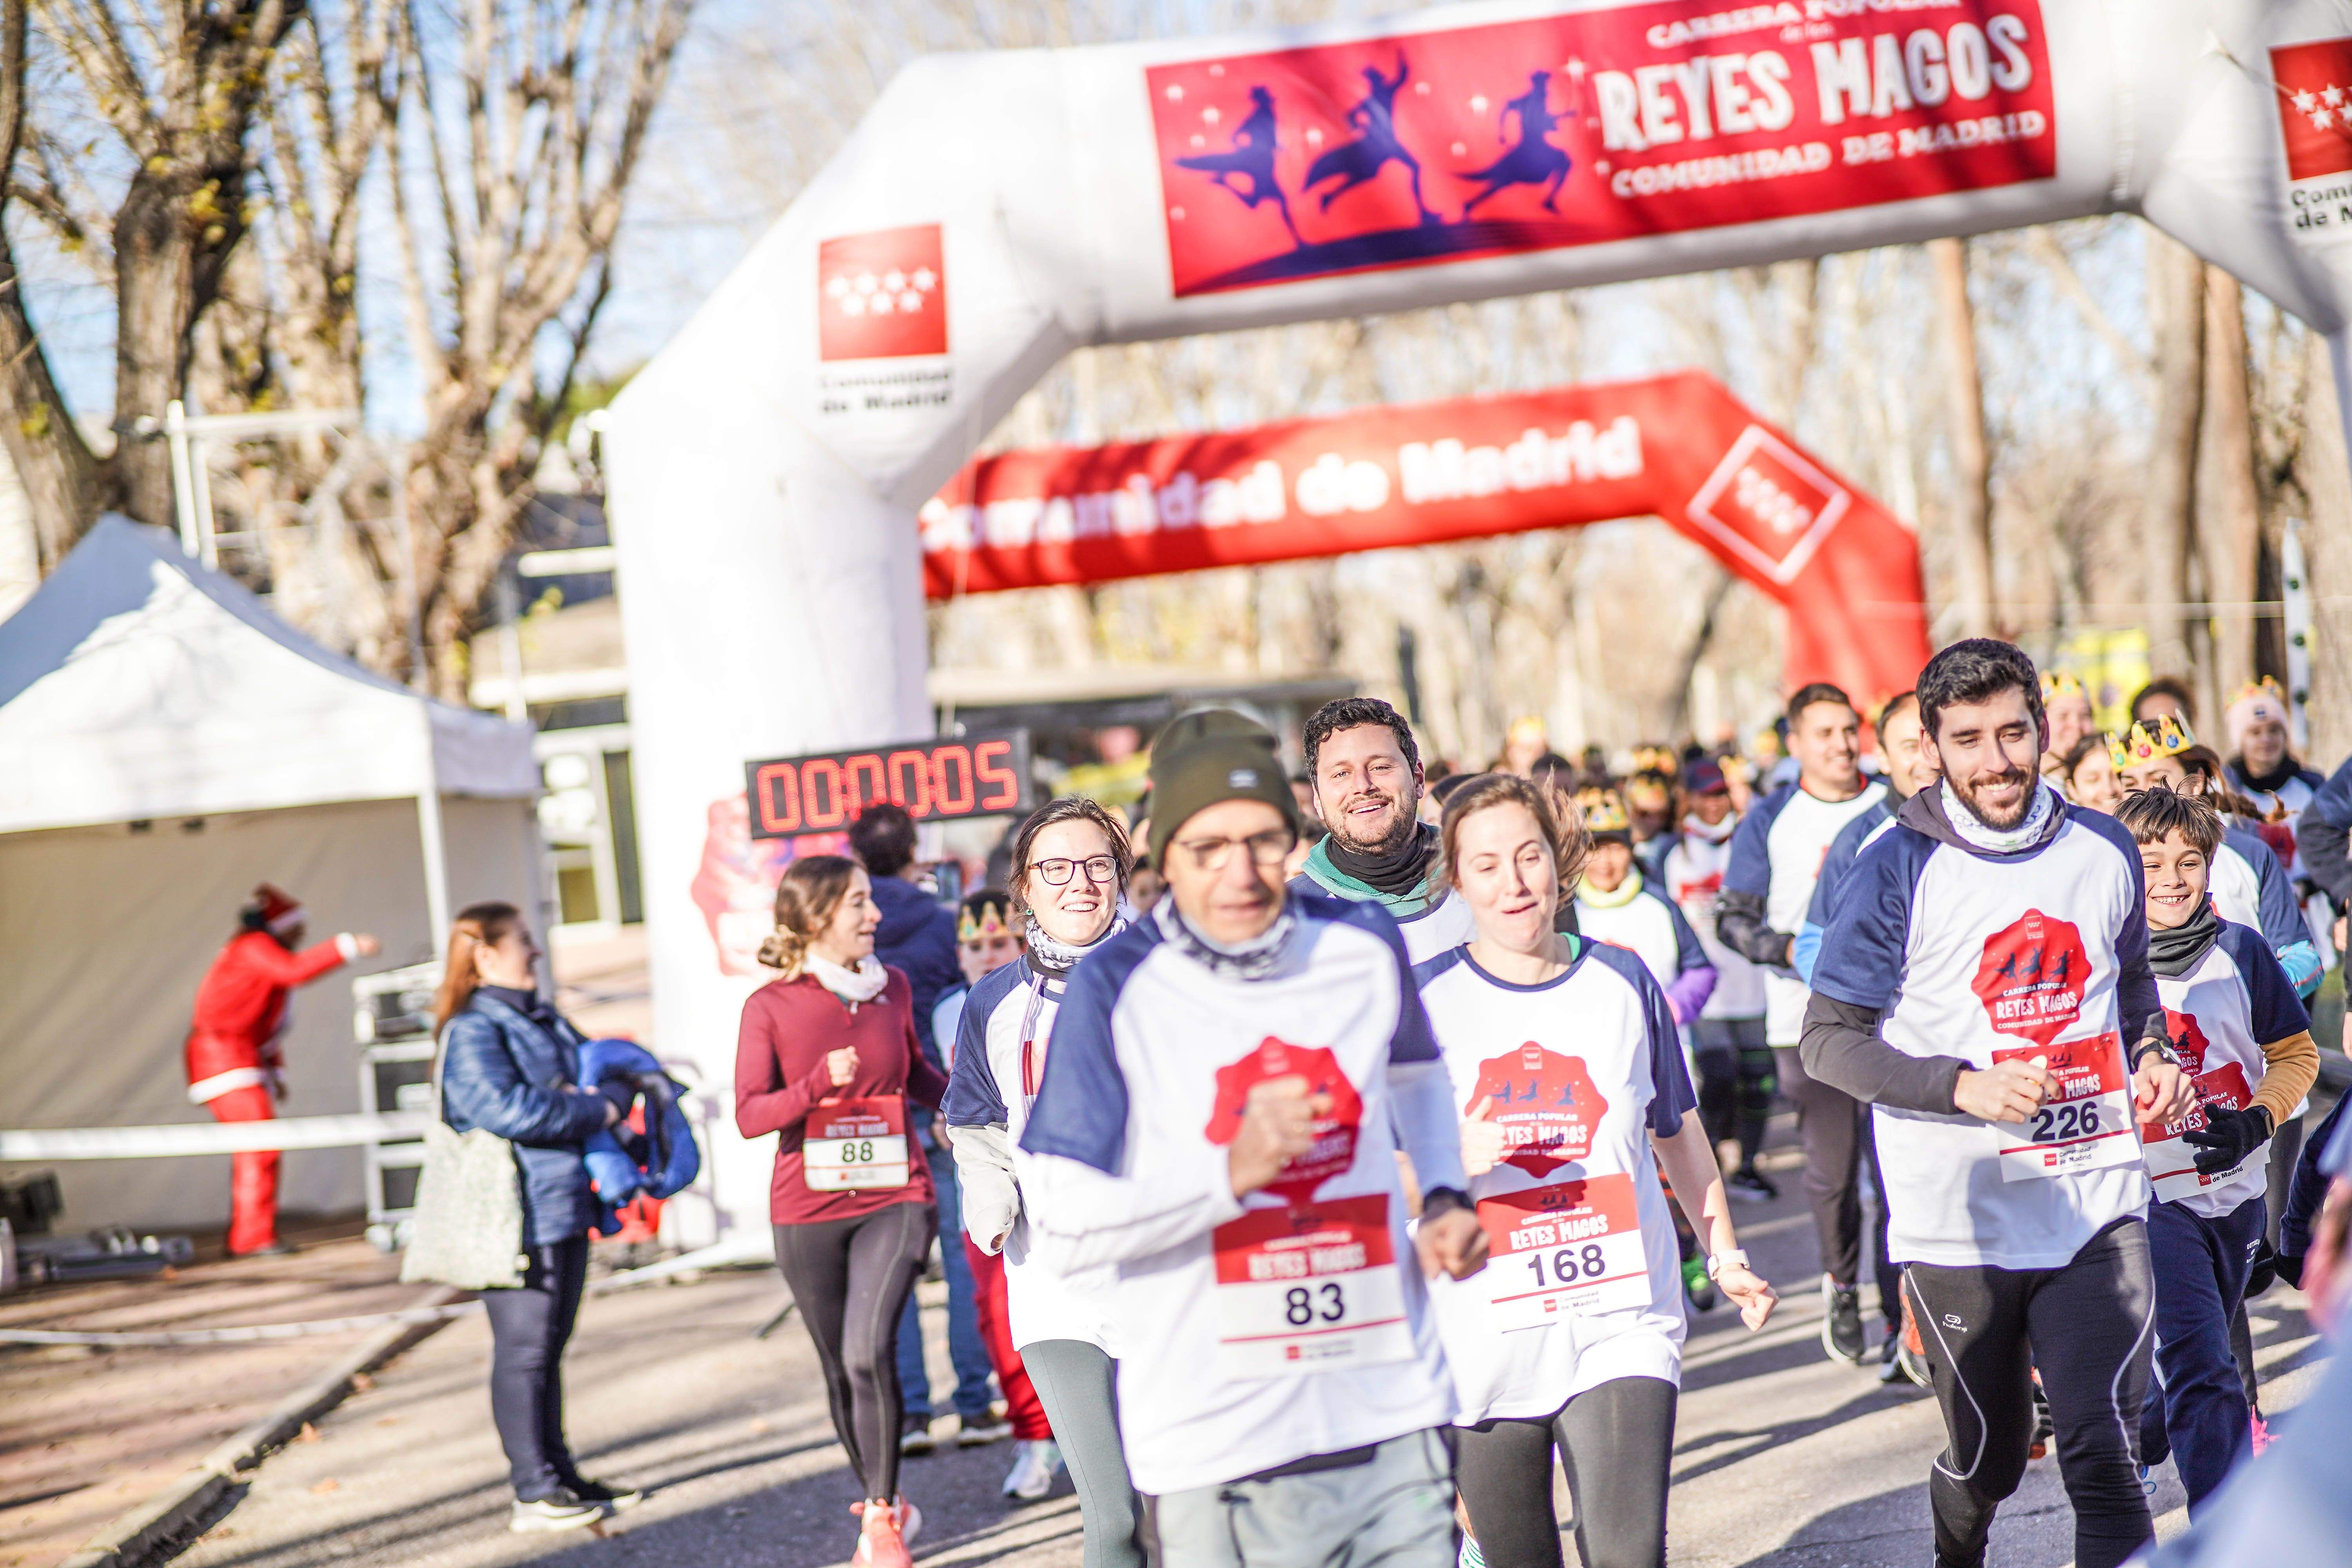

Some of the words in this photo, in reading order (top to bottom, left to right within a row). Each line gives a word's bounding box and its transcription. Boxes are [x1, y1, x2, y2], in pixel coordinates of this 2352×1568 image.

[1647, 2, 1802, 48] CARRERA
[1593, 50, 1795, 151] REYES
[1809, 14, 2032, 125] MAGOS
[1611, 141, 1832, 197] COMUNIDAD
[1842, 132, 1894, 165] DE
[1896, 110, 2046, 158] MADRID
[2297, 208, 2327, 227] de
[1296, 452, 1390, 517] de
[1397, 415, 1643, 505] Madrid
[1996, 998, 2035, 1019] REYES
[2038, 991, 2078, 1014] MAGOS
[1997, 1018, 2043, 1029] COMUNIDAD
[2179, 1056, 2198, 1069] AGOS
[2065, 1074, 2101, 1099] MAGOS
[2201, 1092, 2227, 1104] POPULAR
[2031, 1101, 2099, 1142] 226
[1537, 1125, 1587, 1145] MAGOS
[842, 1141, 873, 1163] 88
[2069, 1154, 2092, 1163] Madrid
[2221, 1165, 2243, 1179] Madrid
[1510, 1224, 1556, 1250] REYES
[1558, 1214, 1609, 1243] MAGOS
[1528, 1244, 1606, 1287] 168
[1287, 1283, 1345, 1325] 83
